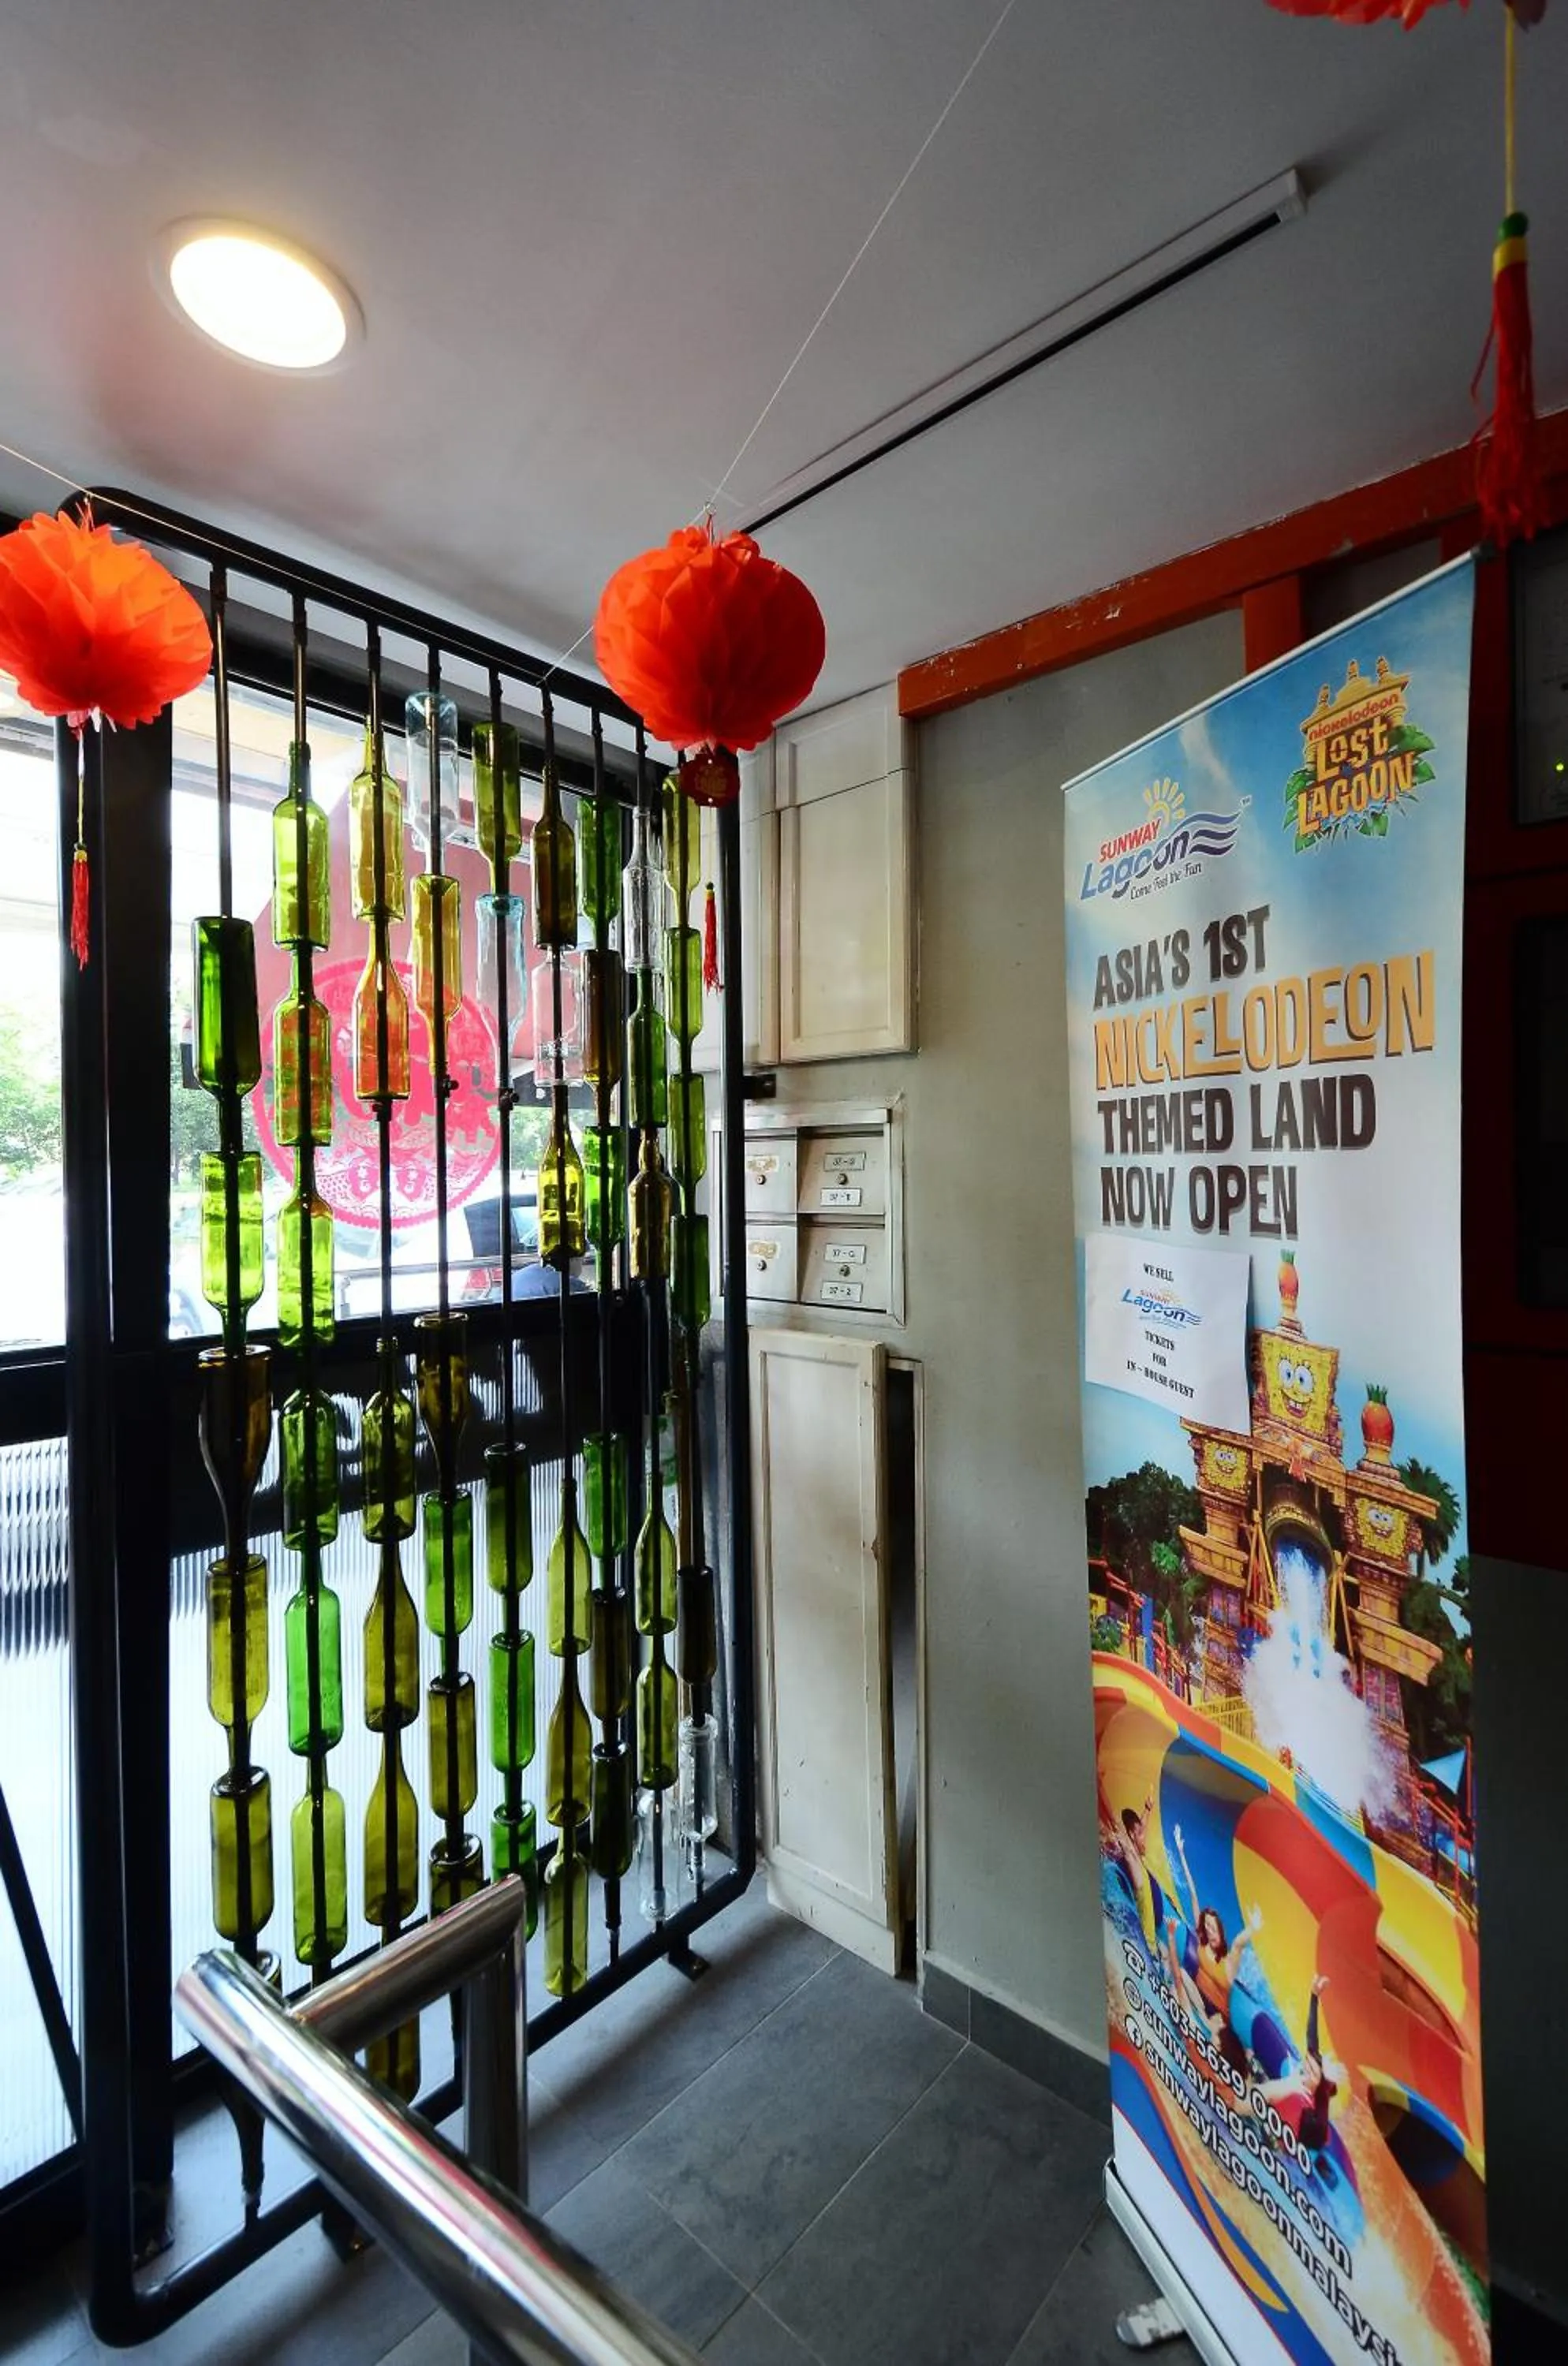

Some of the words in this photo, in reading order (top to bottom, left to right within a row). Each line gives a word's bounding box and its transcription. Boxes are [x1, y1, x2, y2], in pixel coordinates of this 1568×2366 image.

[1309, 693, 1401, 741] nickelodeon
[1315, 716, 1389, 782] Lost
[1297, 751, 1415, 837] LAGOON
[1080, 830, 1190, 900] Lagoon
[1099, 818, 1162, 863] SUNWAY
[1093, 928, 1190, 1011] ASIA'S
[1203, 905, 1271, 983] 1ST
[1094, 950, 1436, 1091] NICKELODEON
[1097, 1087, 1234, 1155] THEMED
[1249, 1073, 1377, 1152] LAND
[1100, 1166, 1176, 1231] NOW
[1189, 1164, 1298, 1241] OPEN
[1121, 1289, 1186, 1322] Lagoon
[1143, 1263, 1155, 1276] WE
[1155, 1267, 1174, 1282] SELL
[1145, 1330, 1174, 1351] TICKETS
[1152, 1353, 1167, 1367] FOR
[1169, 1379, 1194, 1398] GUEST
[1148, 1971, 1246, 2100] +603-5639
[1251, 2088, 1312, 2176] 0000
[1143, 2001, 1353, 2280] sunwaylagoon.com
[1145, 2040, 1402, 2366] sunwaylagoonmalaysi
